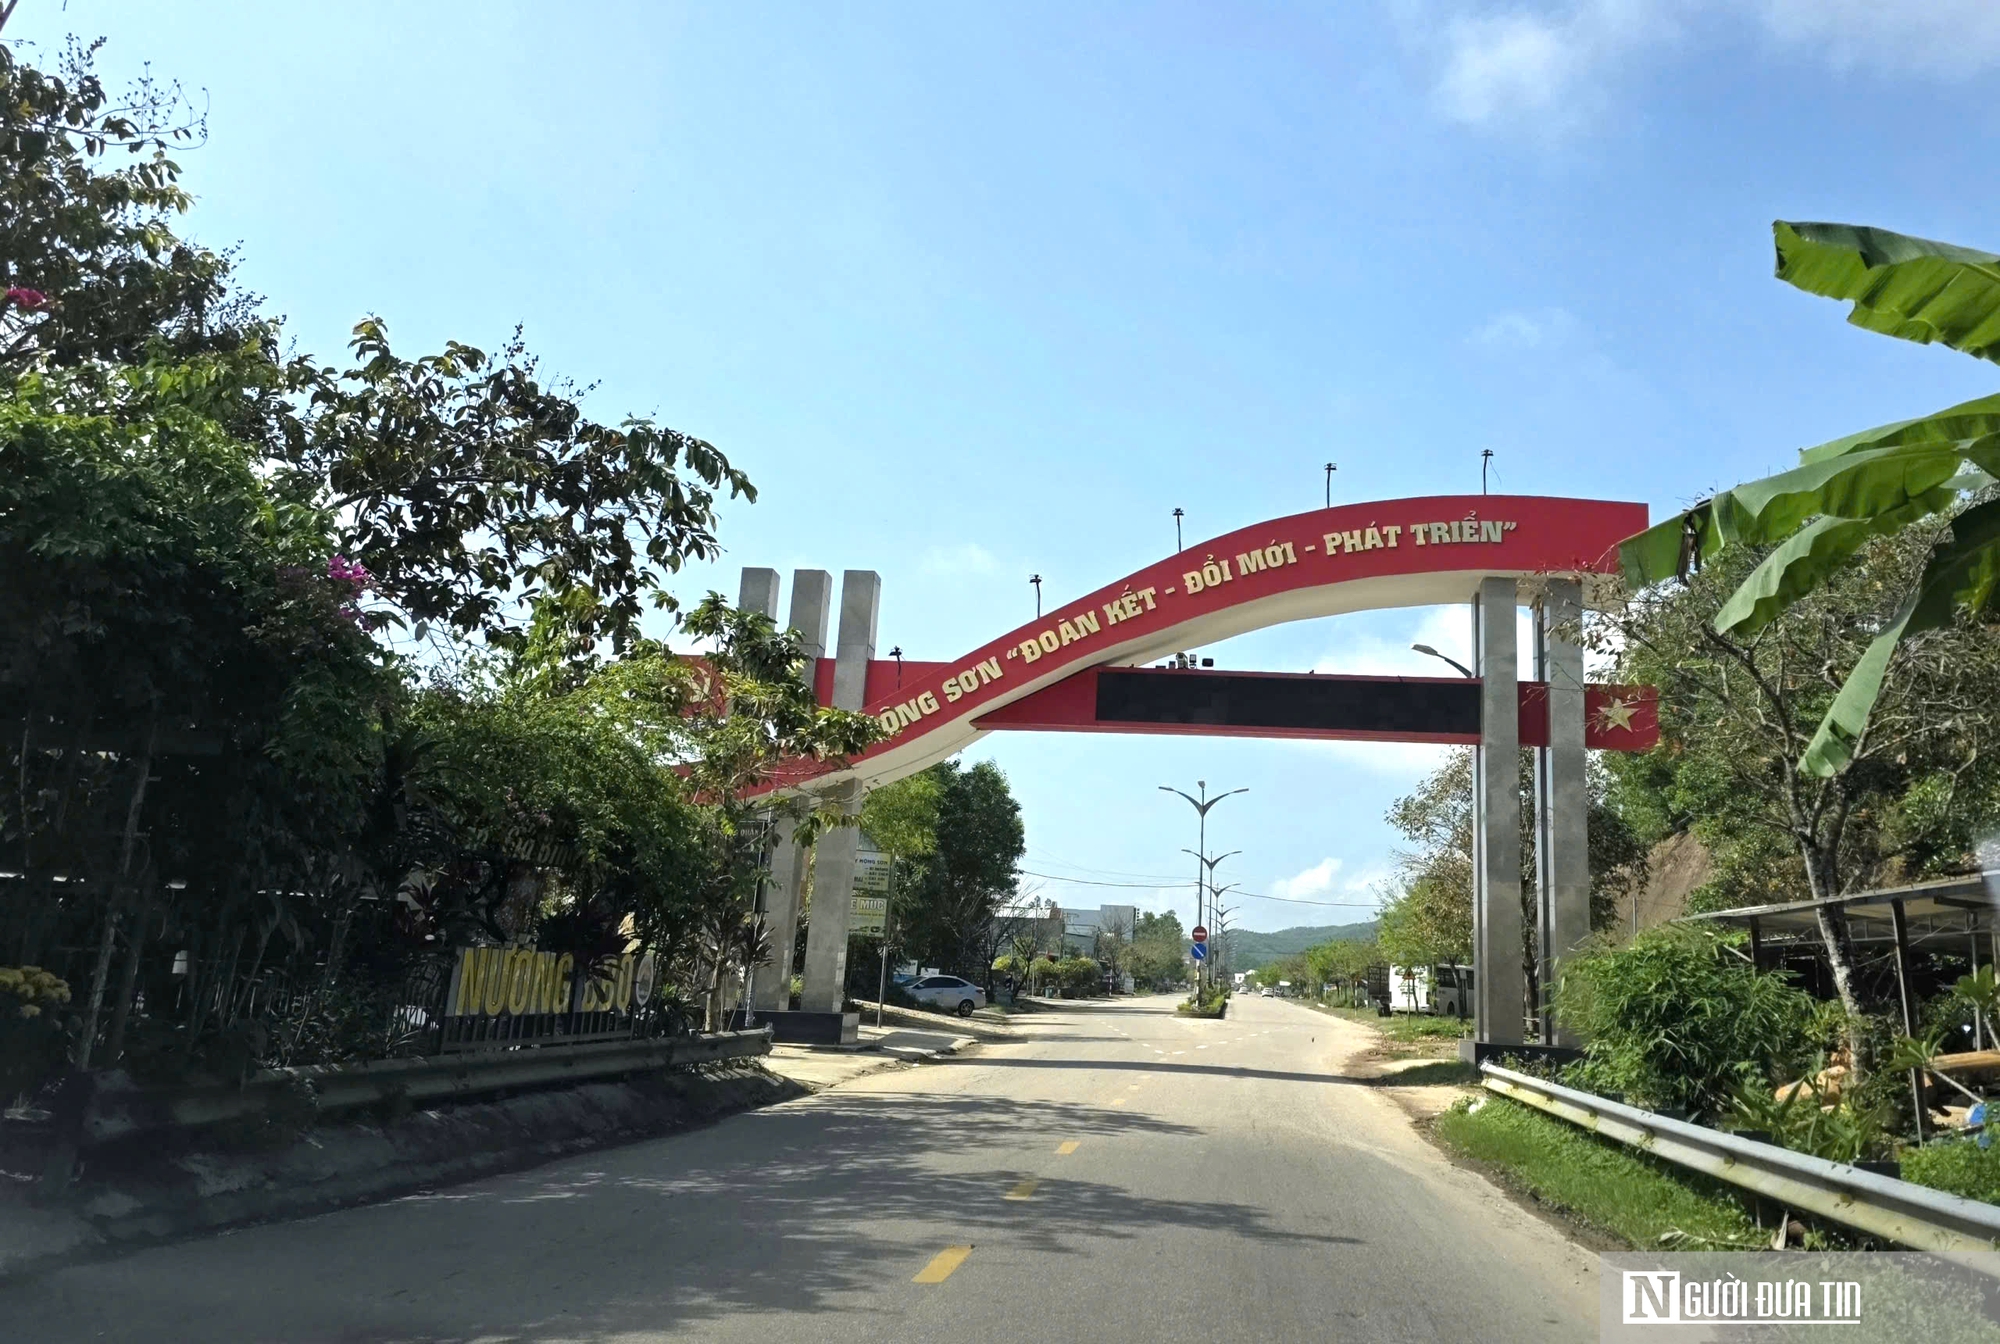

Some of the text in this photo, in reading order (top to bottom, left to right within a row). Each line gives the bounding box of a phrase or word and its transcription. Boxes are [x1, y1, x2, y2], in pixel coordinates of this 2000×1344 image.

[879, 690, 940, 735] ÔNG
[941, 656, 1003, 704] SƠN
[1102, 584, 1157, 626] KẾT
[1183, 554, 1233, 595] ĐỔI
[1235, 538, 1297, 576] MỚI
[1323, 520, 1401, 556] PHÁT
